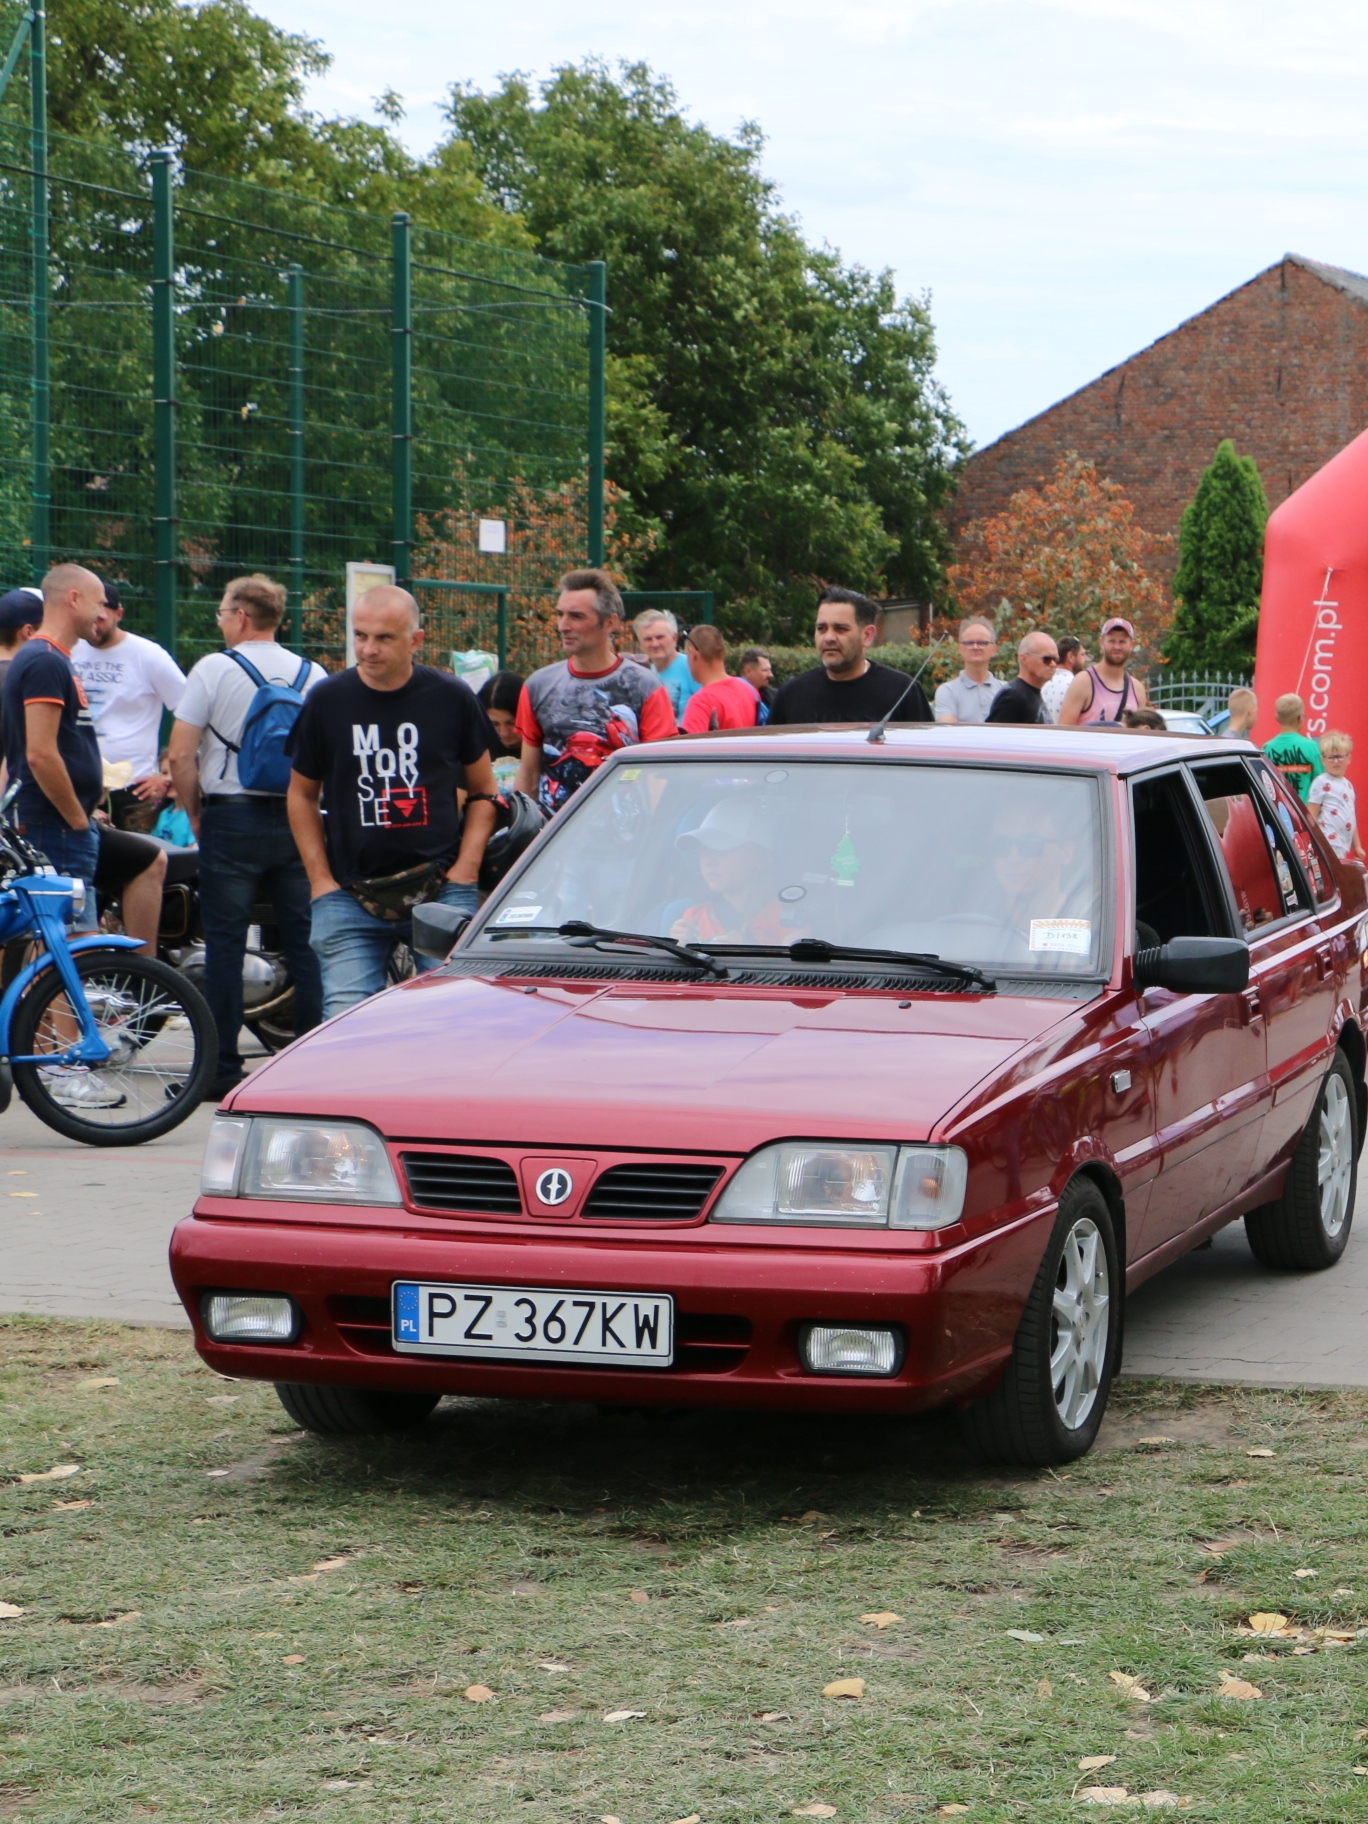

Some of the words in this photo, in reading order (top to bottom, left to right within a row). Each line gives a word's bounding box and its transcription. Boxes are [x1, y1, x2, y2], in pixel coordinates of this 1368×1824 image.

[401, 1319, 417, 1333] PL
[428, 1291, 494, 1341] PZ
[513, 1297, 661, 1350] 367KW
